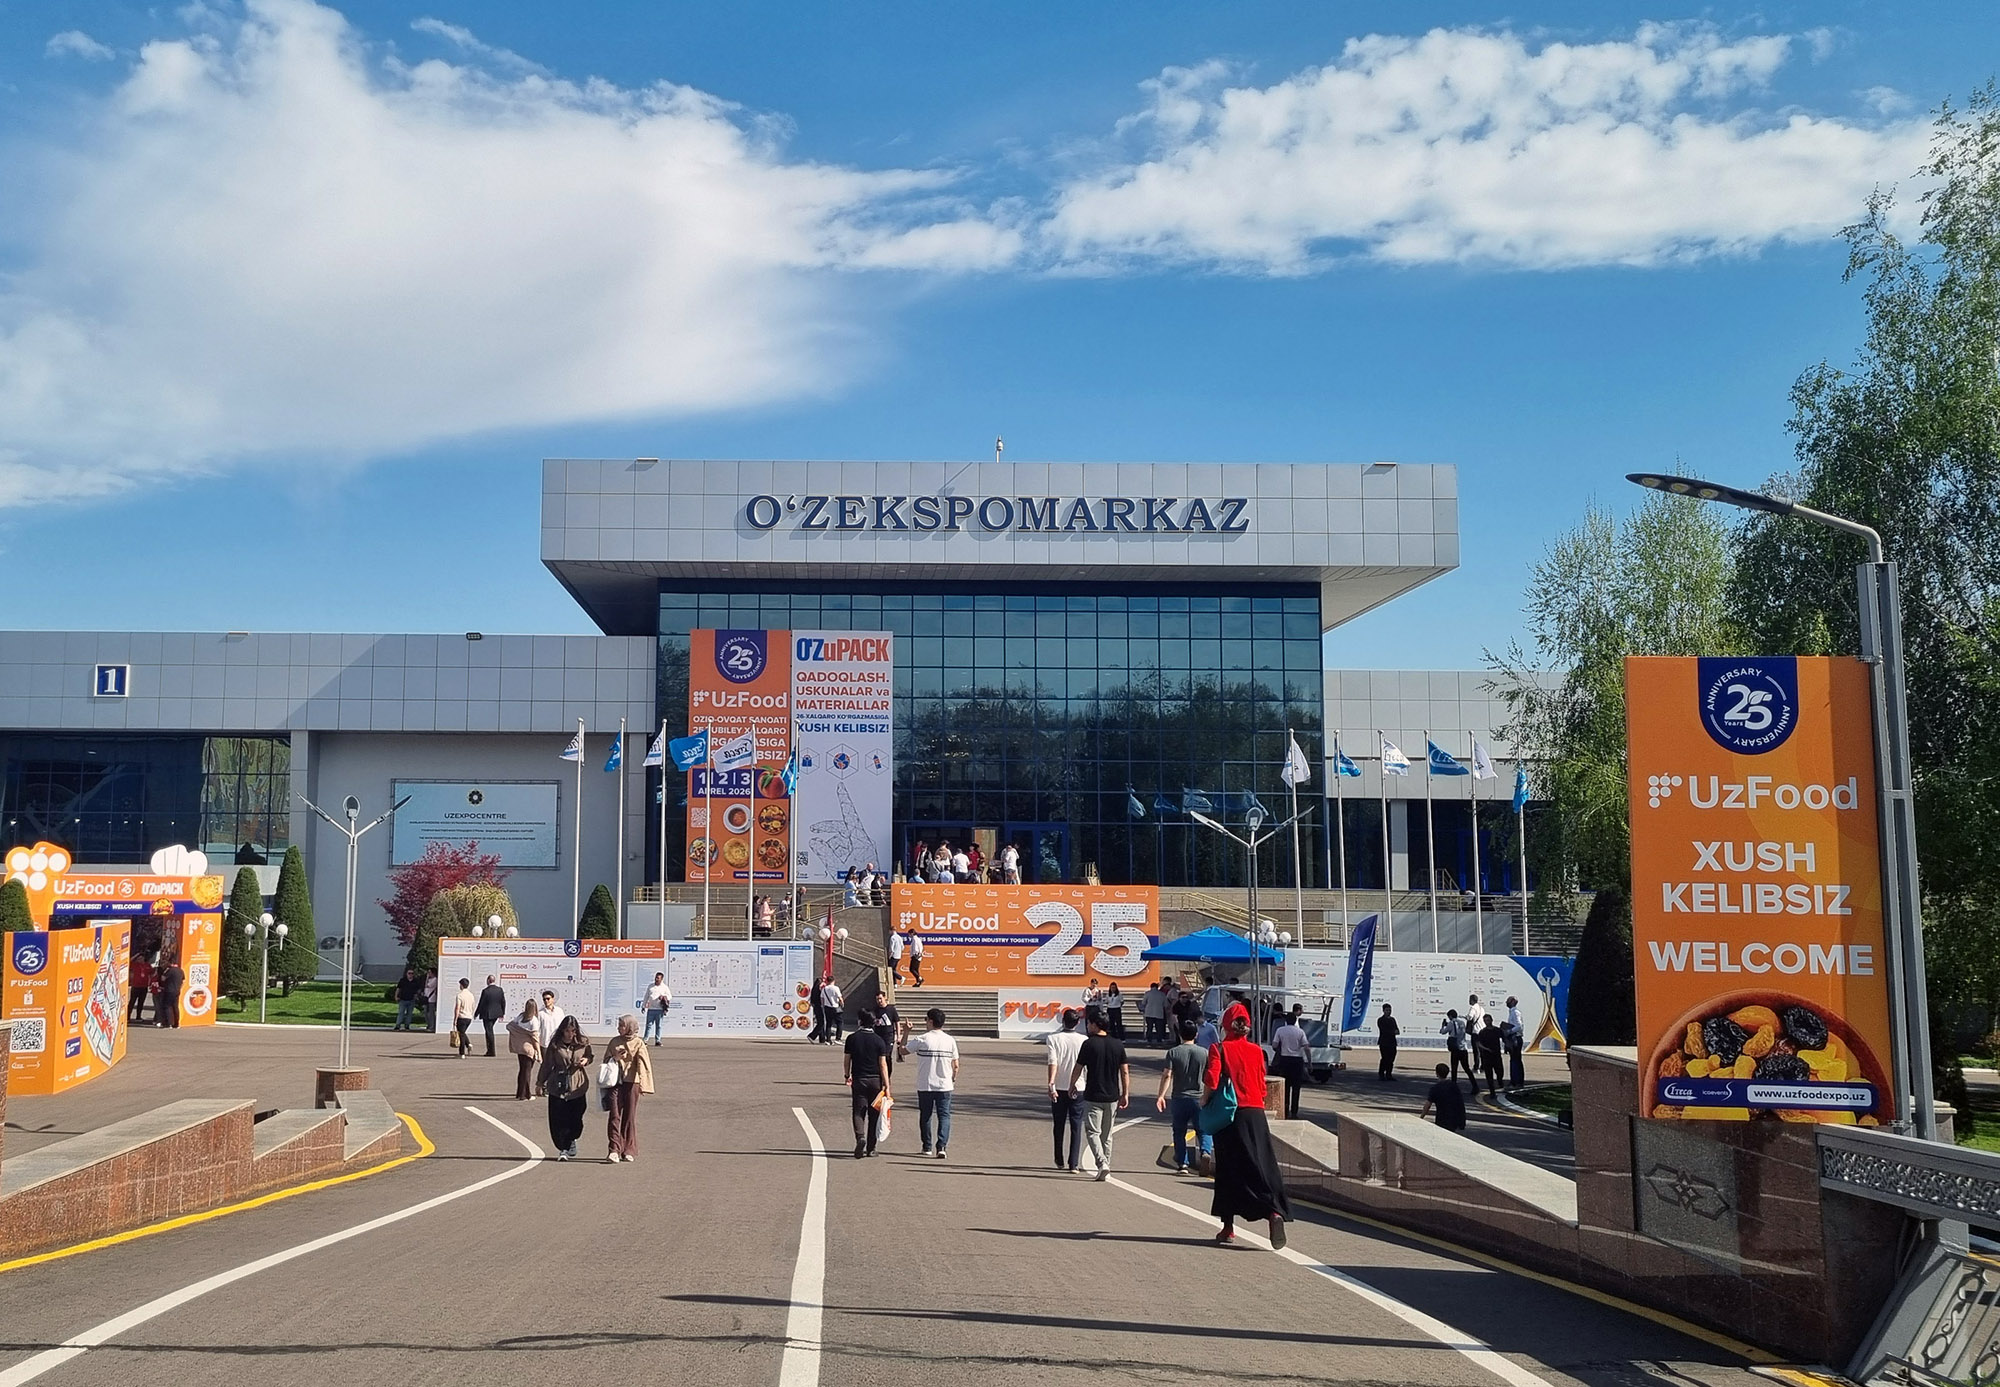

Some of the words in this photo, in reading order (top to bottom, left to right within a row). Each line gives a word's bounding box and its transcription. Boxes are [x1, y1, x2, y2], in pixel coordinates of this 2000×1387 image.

[727, 645, 753, 670] 25
[104, 668, 119, 693] 1
[796, 671, 890, 683] QADOQLASH.
[796, 686, 873, 696] USKUNALAR
[876, 688, 890, 696] va
[1707, 668, 1762, 710] ANNIVERSARY
[711, 690, 788, 708] UzFood
[796, 699, 890, 710] MATERIALLAR
[1724, 684, 1773, 730] 25
[748, 716, 787, 724] SANOATI
[797, 723, 831, 733] XUSH
[833, 723, 890, 733] KELIBSIZ!
[1733, 705, 1791, 746] ANNIVERSARY
[698, 771, 706, 785] 1
[718, 772, 729, 785] 2
[740, 772, 751, 785] 3
[1689, 775, 1858, 810] UzFood
[1692, 841, 1816, 872] XUSH
[53, 879, 115, 895] UzFood
[1662, 883, 1852, 916] KELIBSIZ
[919, 912, 999, 930] UzFood
[1023, 901, 1152, 977] 25
[69, 941, 95, 964] UzFood
[592, 944, 633, 954] UzFood
[20, 950, 40, 967] 25
[1648, 941, 1874, 976] WELCOME
[17, 978, 48, 987] UzFood
[1753, 1089, 1866, 1102] www.uzfoodexpo.uz
